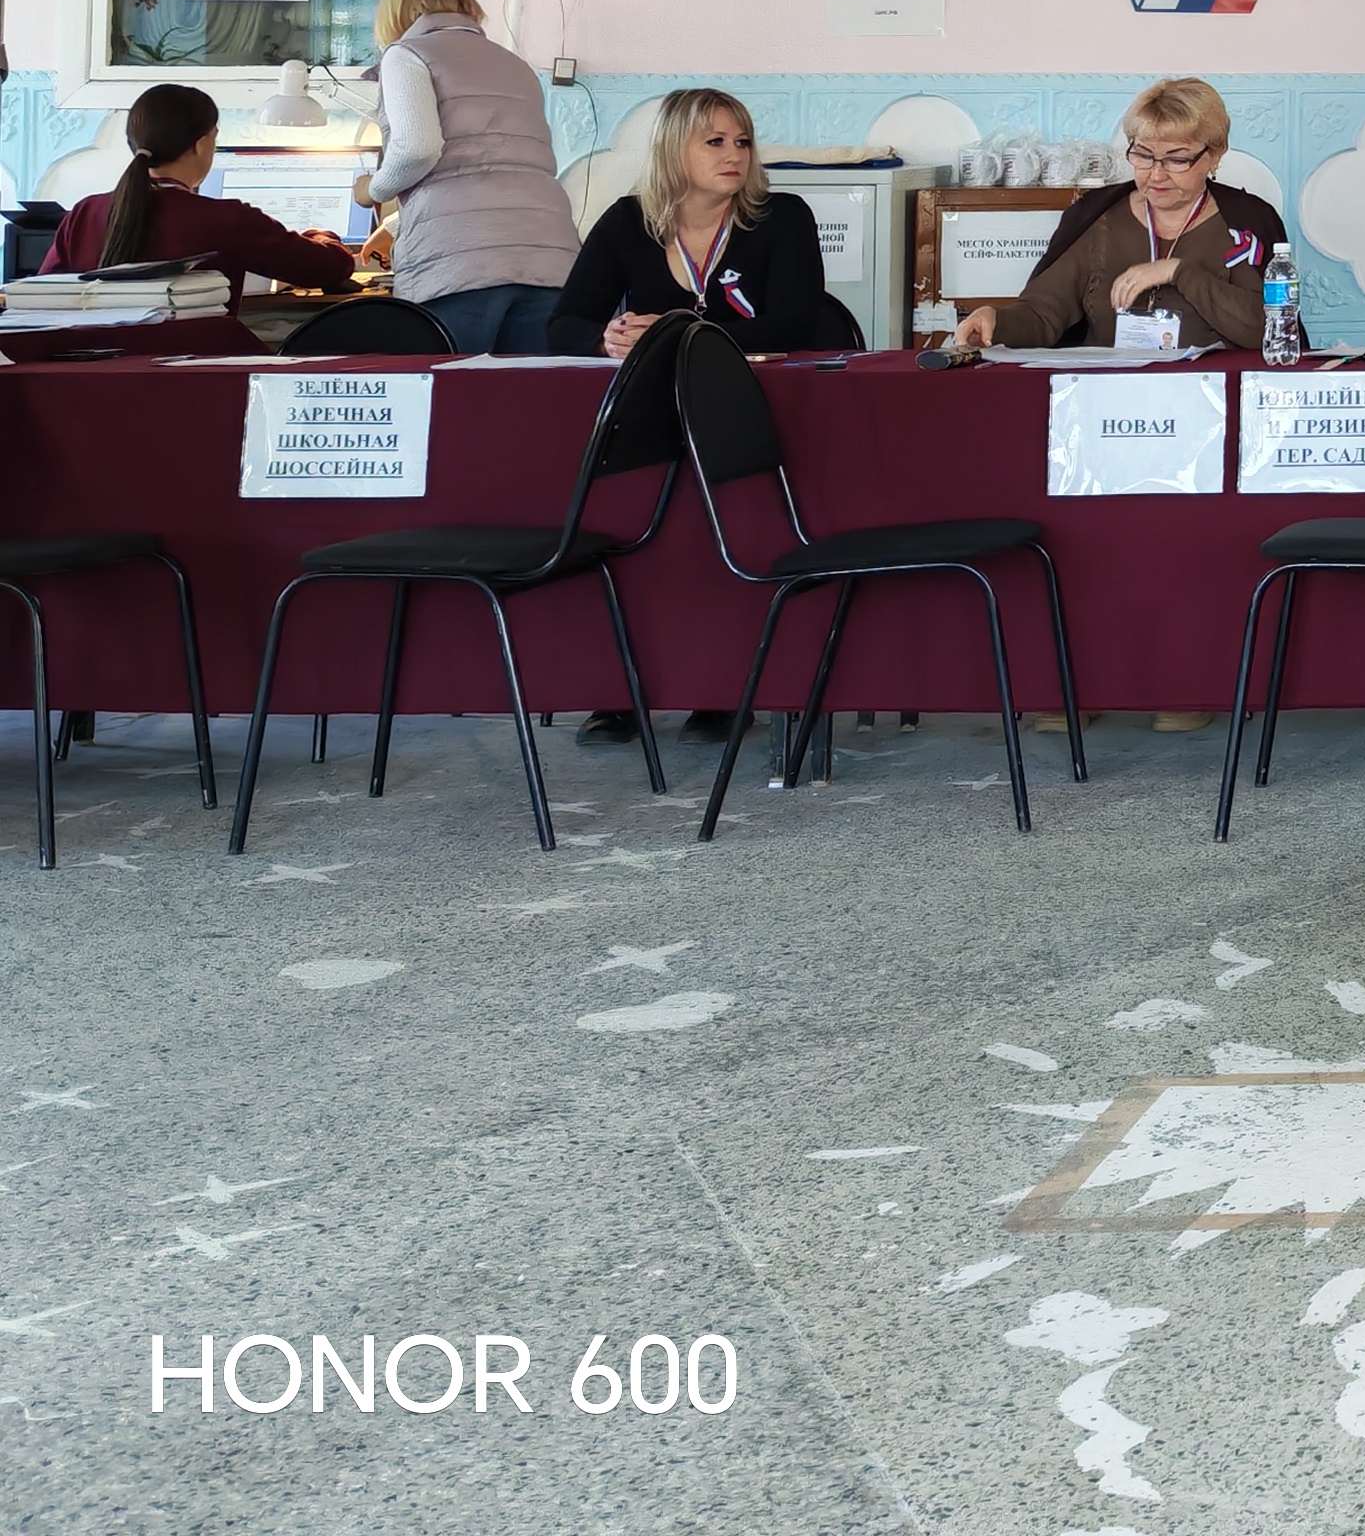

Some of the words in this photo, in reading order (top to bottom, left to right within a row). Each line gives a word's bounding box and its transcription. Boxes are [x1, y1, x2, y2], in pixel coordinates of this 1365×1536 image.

[956, 239, 994, 249] МЕСТО
[996, 239, 1050, 248] ХРАНЕНИЯ
[294, 378, 387, 395] ЗЕЛЁНАЯ
[286, 407, 392, 422] ЗАРЕЧНАЯ
[1101, 419, 1176, 434] НОВАЯ
[277, 434, 398, 449] ШКОЛЬНАЯ
[1275, 448, 1318, 464] ТЕР.
[267, 458, 404, 475] ШОССЕЙНАЯ
